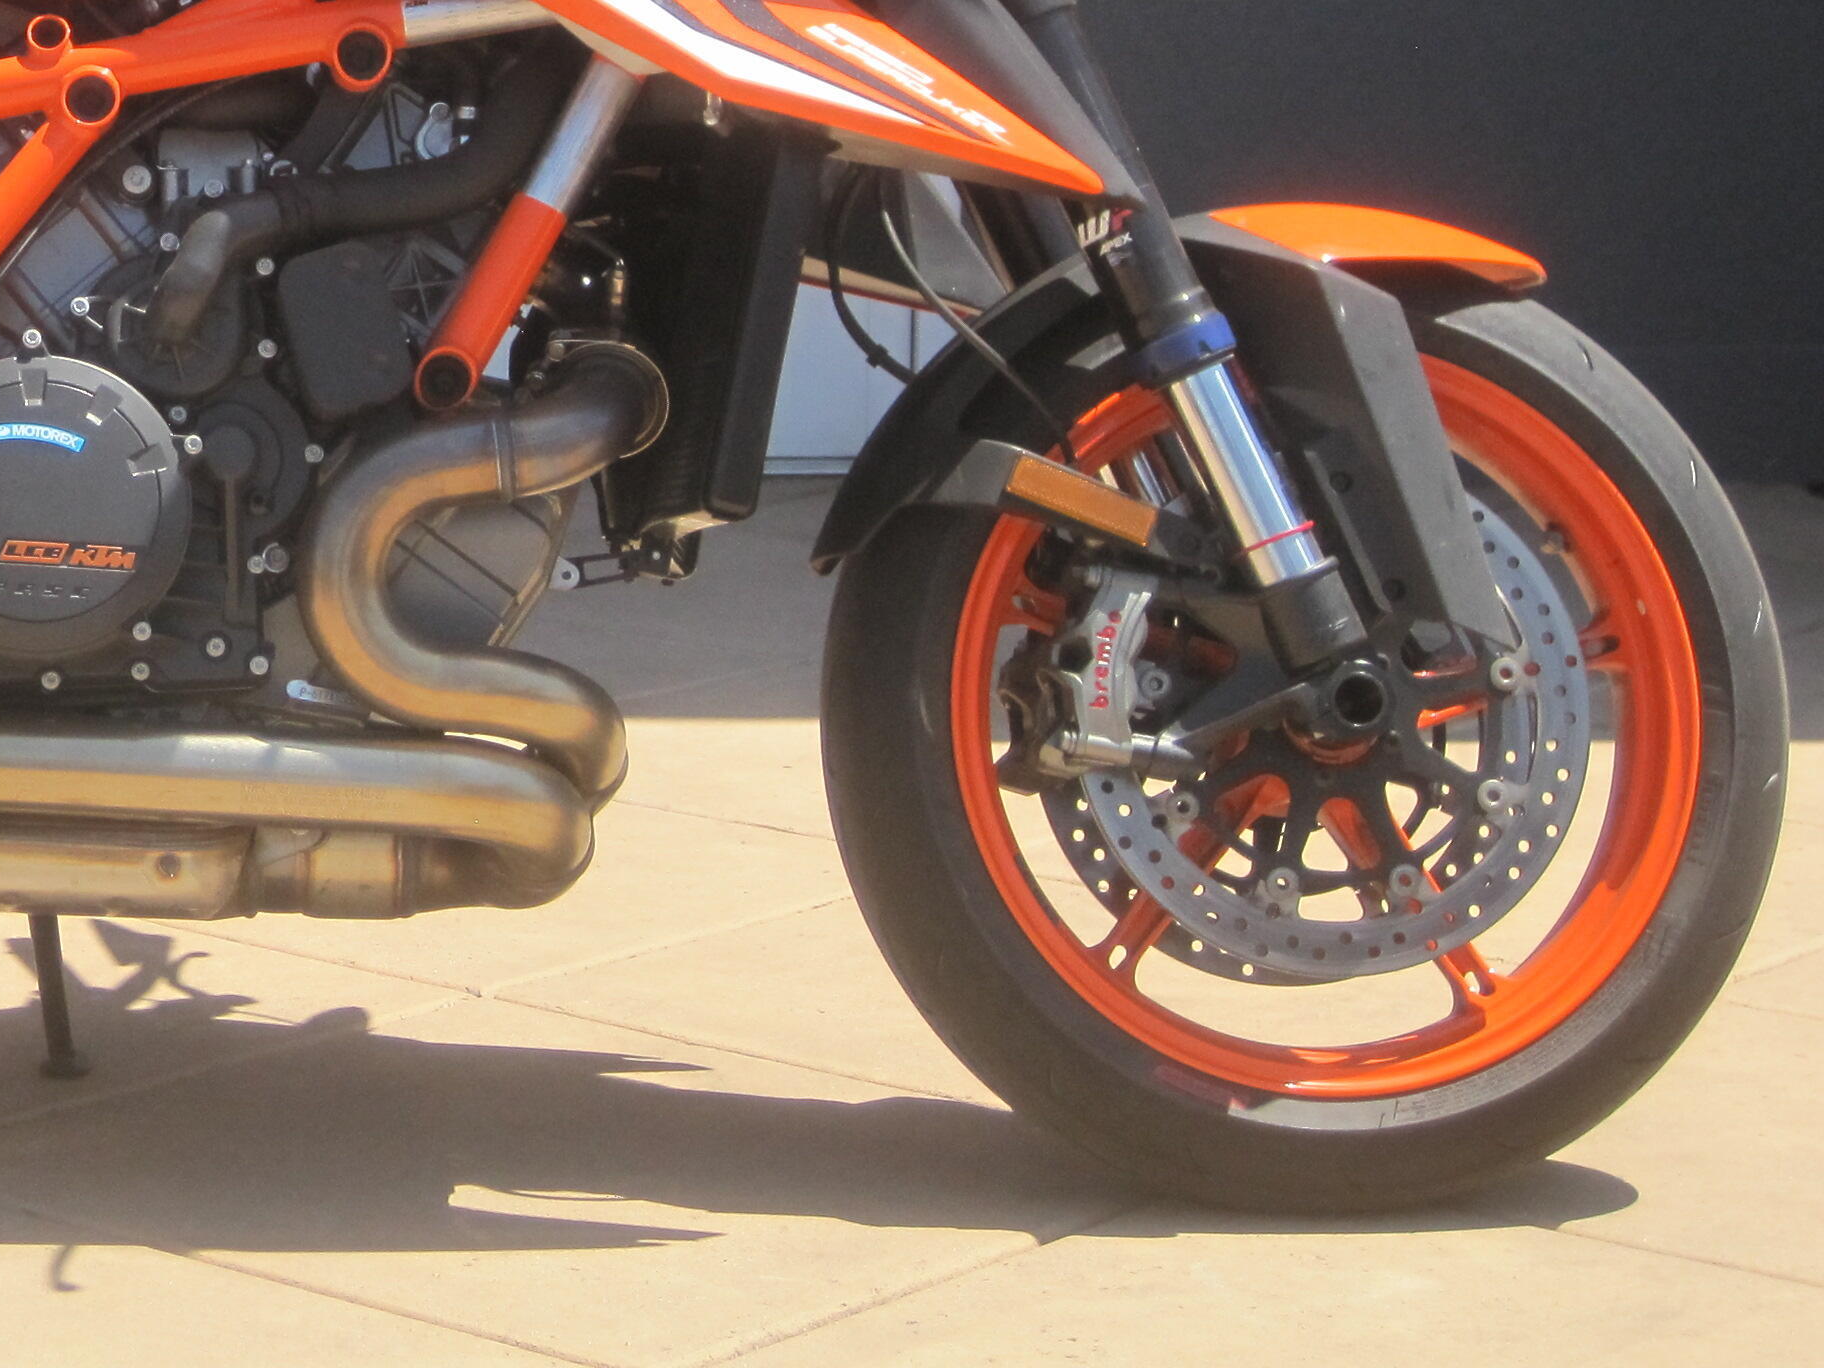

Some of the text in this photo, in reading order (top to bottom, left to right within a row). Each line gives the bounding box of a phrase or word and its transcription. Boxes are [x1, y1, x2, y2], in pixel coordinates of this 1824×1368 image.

[12, 424, 80, 448] MOTOREX
[69, 543, 136, 569] KTM
[1089, 608, 1122, 709] brembo
